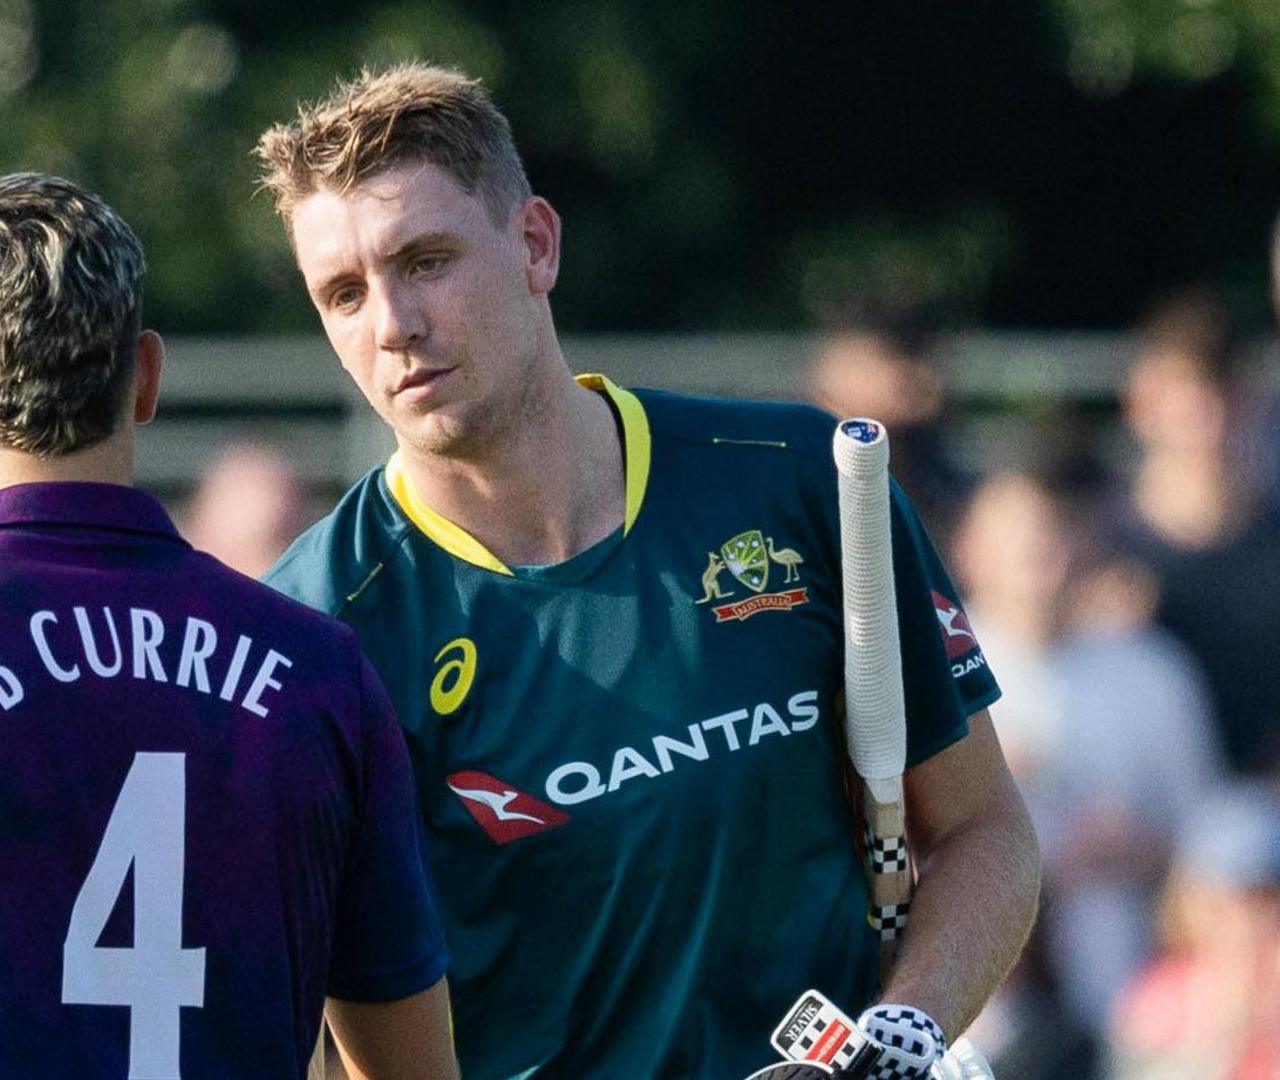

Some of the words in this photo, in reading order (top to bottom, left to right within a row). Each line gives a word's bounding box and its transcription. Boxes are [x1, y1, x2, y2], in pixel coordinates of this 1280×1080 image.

[30, 606, 293, 718] CURRIE
[545, 690, 818, 806] QANTAS
[61, 752, 206, 1080] 4
[785, 1003, 818, 1041] SILVER
